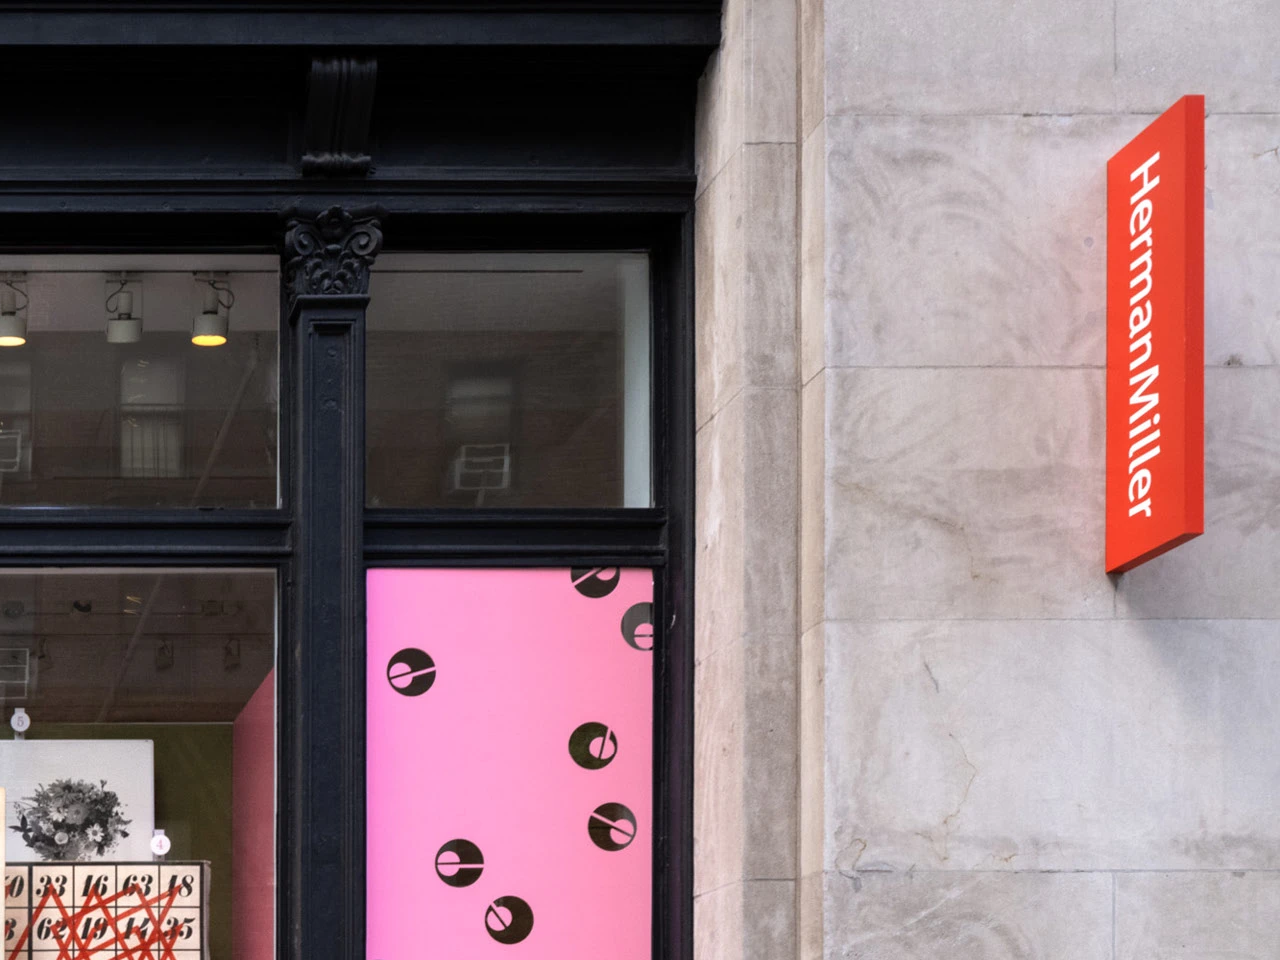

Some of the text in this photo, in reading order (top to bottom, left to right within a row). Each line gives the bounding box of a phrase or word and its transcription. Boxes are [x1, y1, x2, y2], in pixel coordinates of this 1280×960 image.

[1129, 151, 1161, 517] HermanMiller
[17, 716, 24, 727] 5
[155, 837, 163, 850] 4
[35, 875, 67, 897] 33
[81, 875, 108, 896] 16
[123, 875, 153, 897] 63
[167, 875, 194, 897] 18
[37, 918, 68, 940] 62
[81, 918, 108, 940] 19
